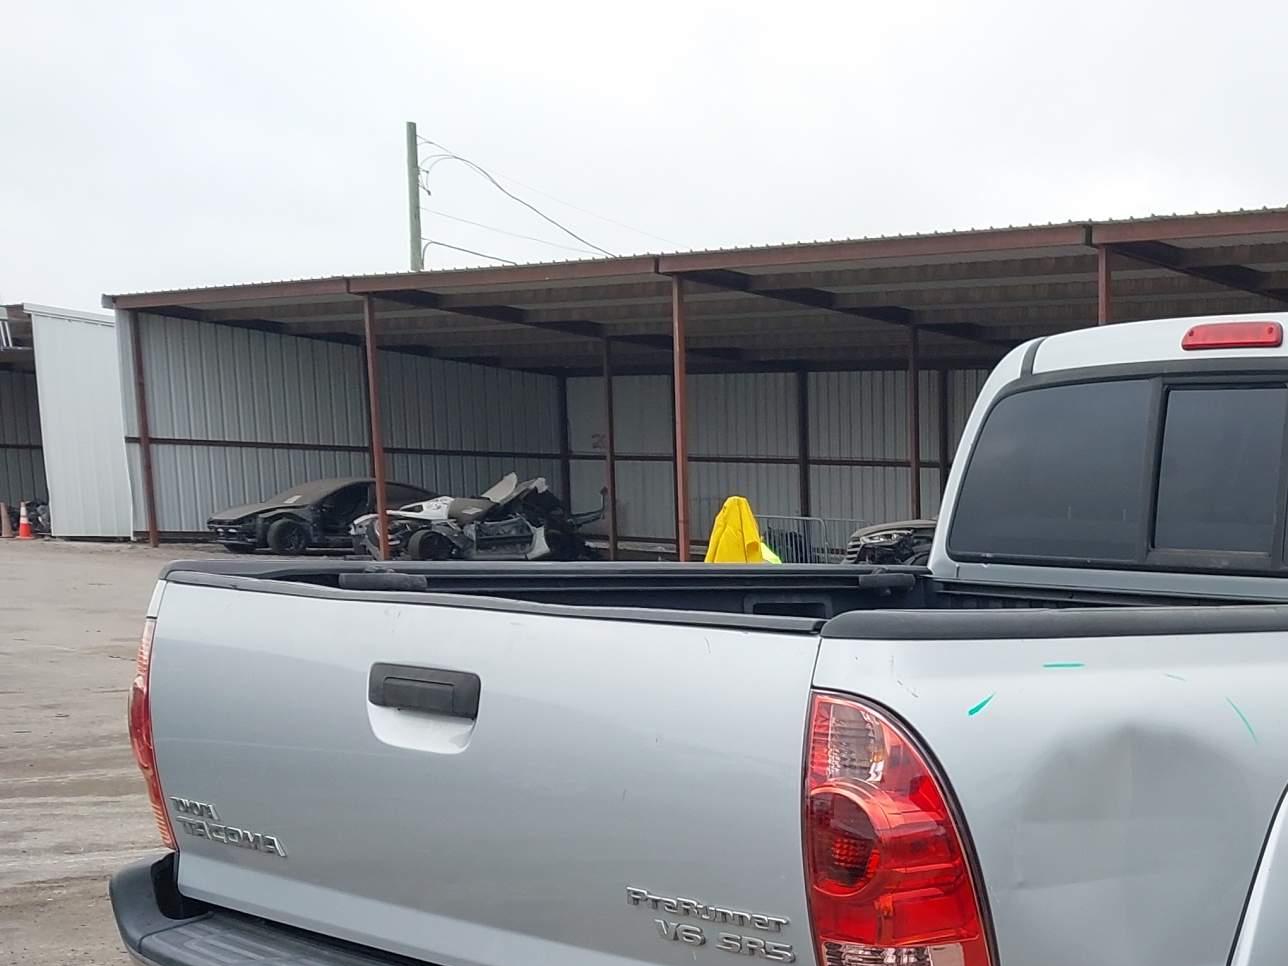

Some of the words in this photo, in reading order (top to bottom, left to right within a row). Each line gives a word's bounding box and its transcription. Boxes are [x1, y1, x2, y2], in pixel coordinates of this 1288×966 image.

[176, 815, 287, 857] TACOMA
[625, 886, 791, 932] PreRunner
[654, 919, 706, 946] V6
[715, 932, 796, 964] SR5
